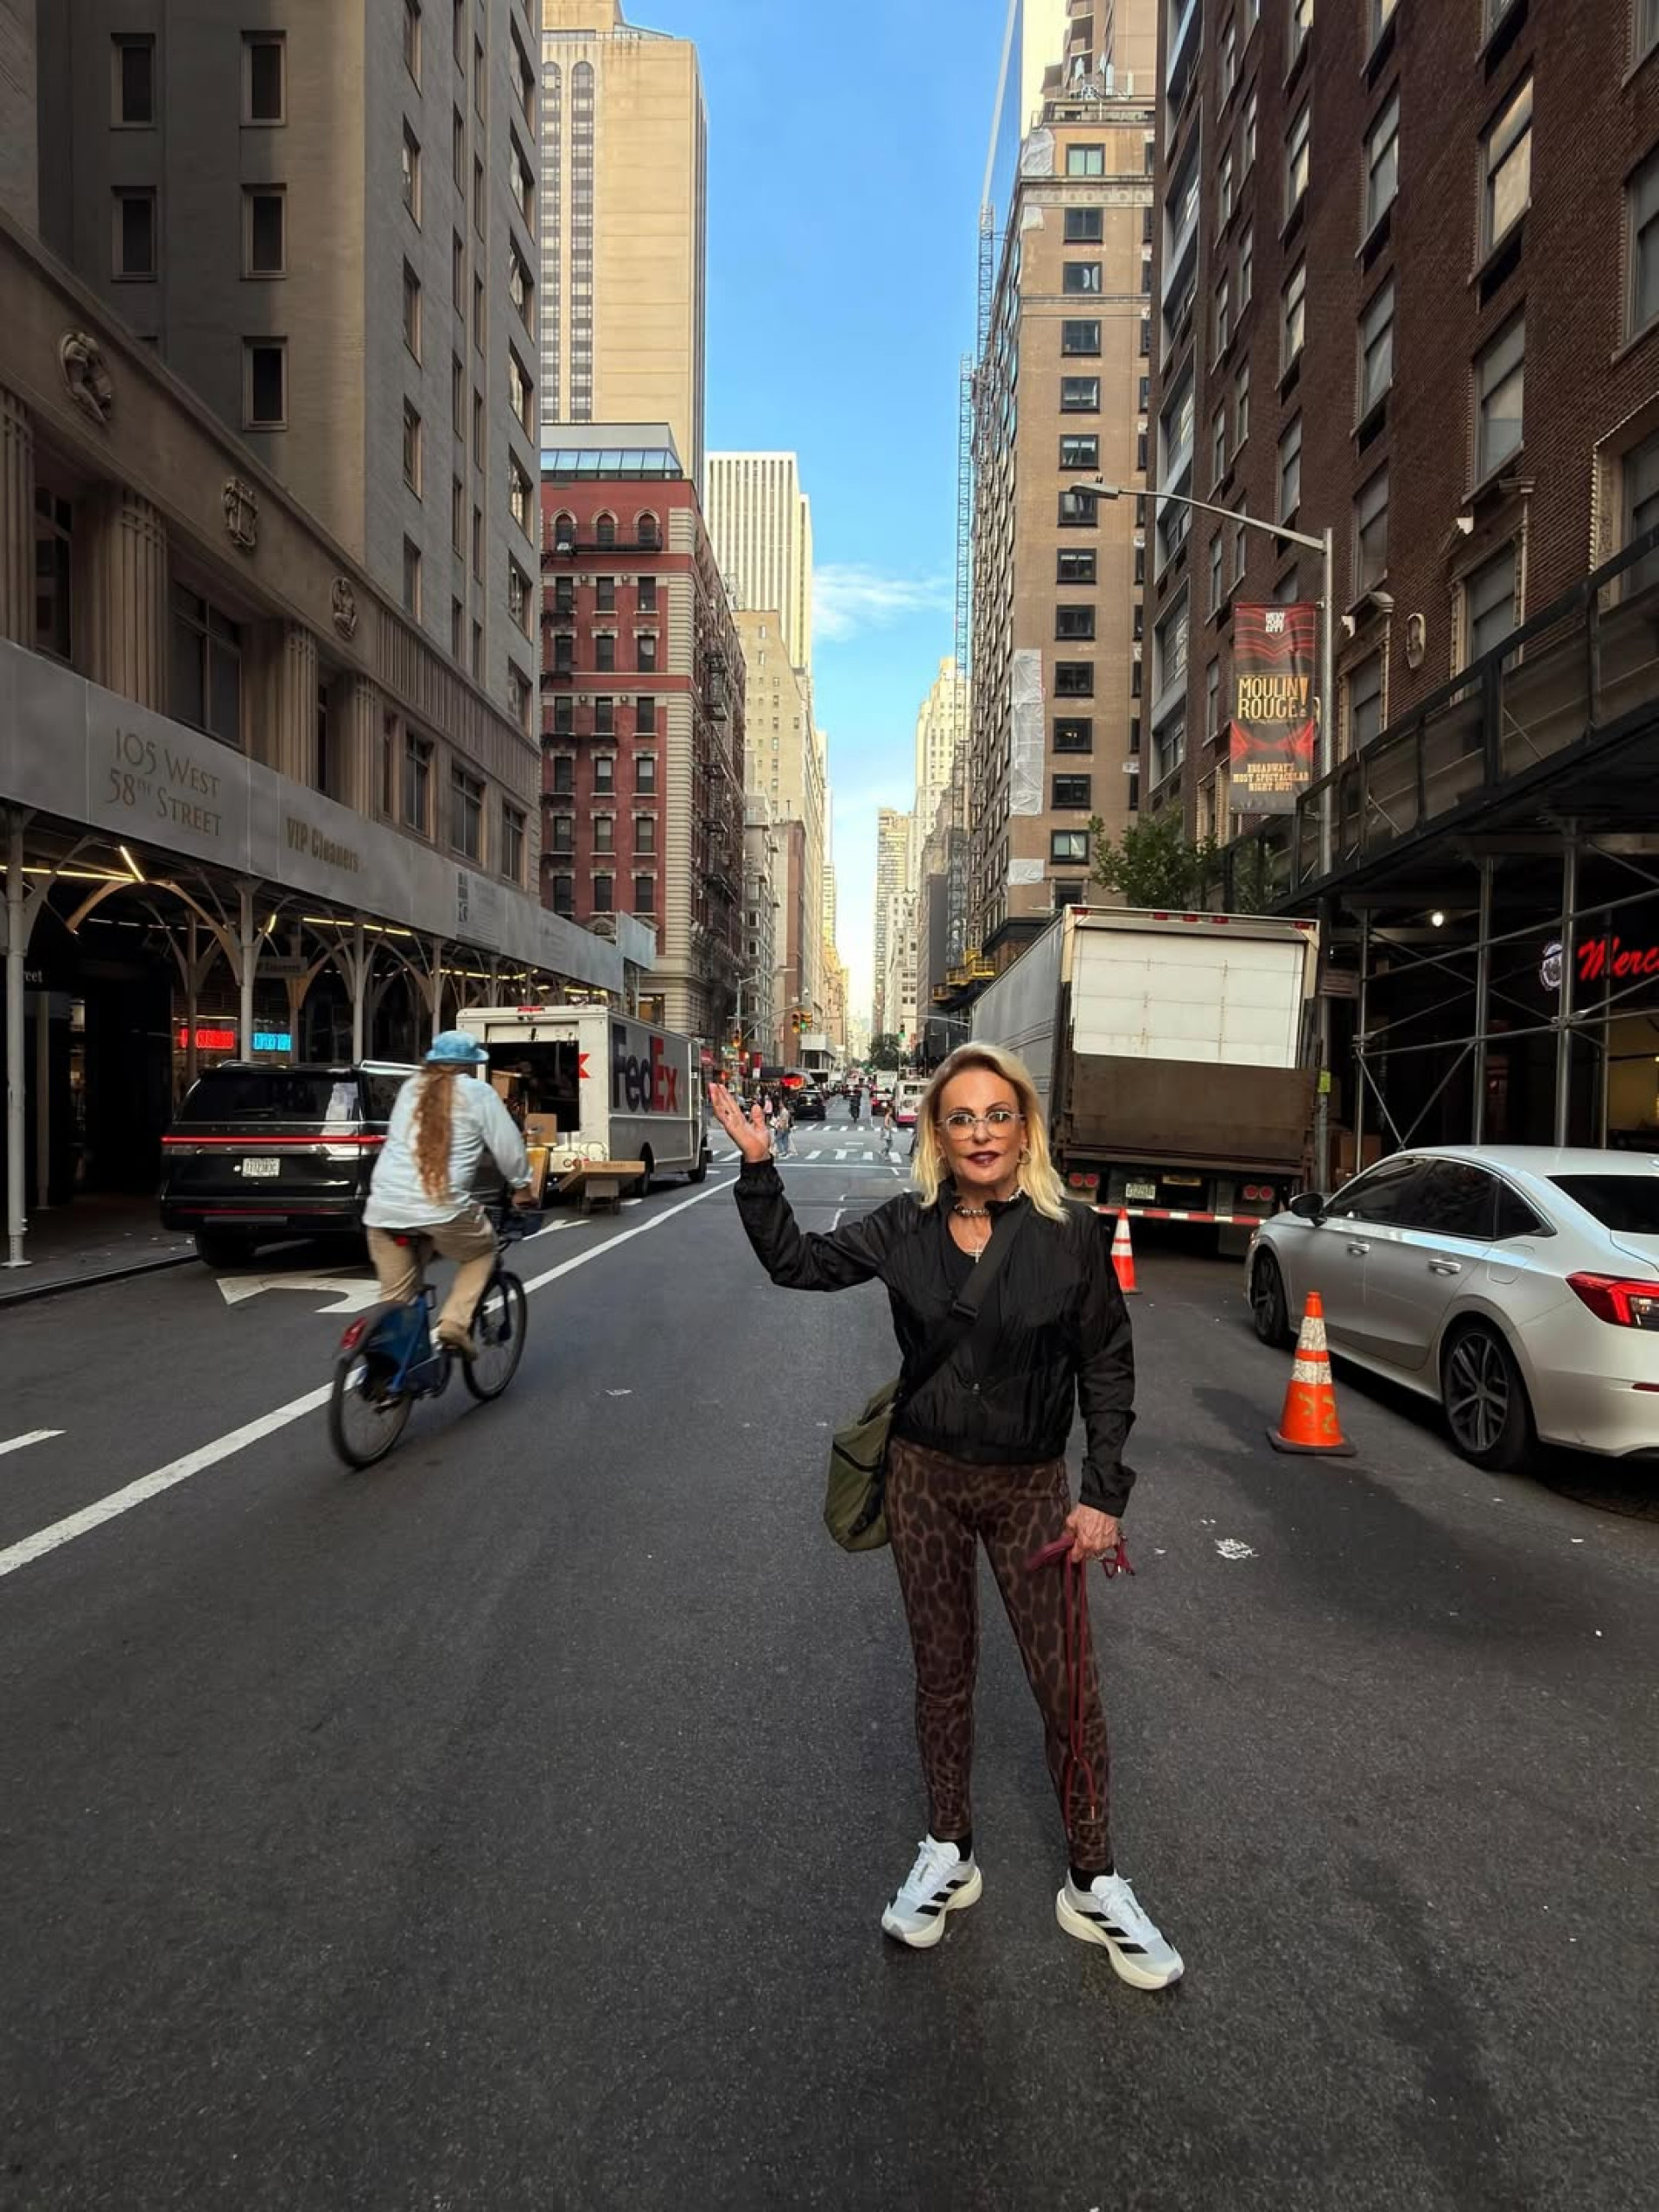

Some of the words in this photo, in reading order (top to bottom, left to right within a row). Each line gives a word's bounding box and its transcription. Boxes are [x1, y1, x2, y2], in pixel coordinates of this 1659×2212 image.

[116, 728, 156, 775] 105
[285, 817, 308, 854] VIP
[311, 826, 361, 874] Cleaners
[612, 1022, 679, 1113] FedEx
